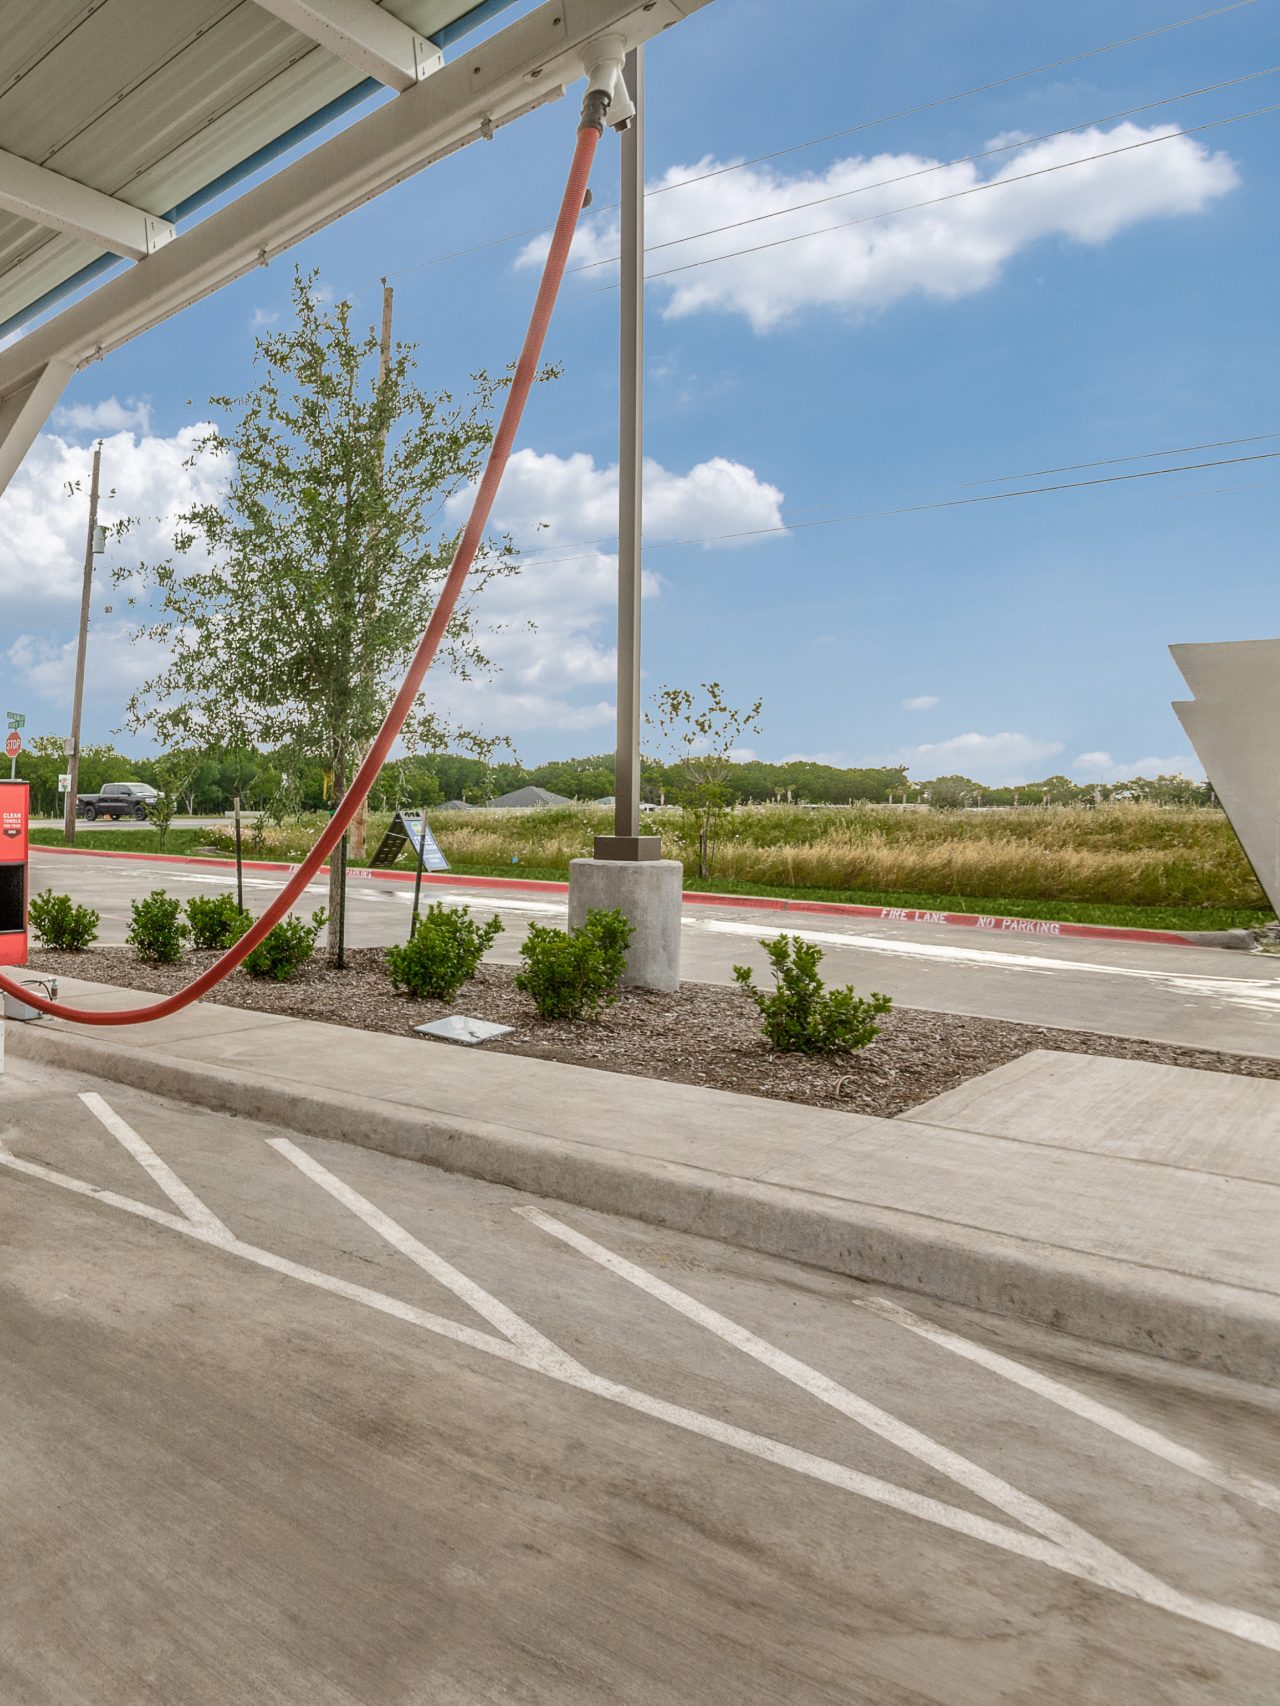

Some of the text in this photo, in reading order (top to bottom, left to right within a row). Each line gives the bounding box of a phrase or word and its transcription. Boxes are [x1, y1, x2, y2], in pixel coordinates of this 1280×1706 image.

[6, 739, 21, 750] STOP
[880, 908, 1061, 935] FIRE LANE NO PARKING
